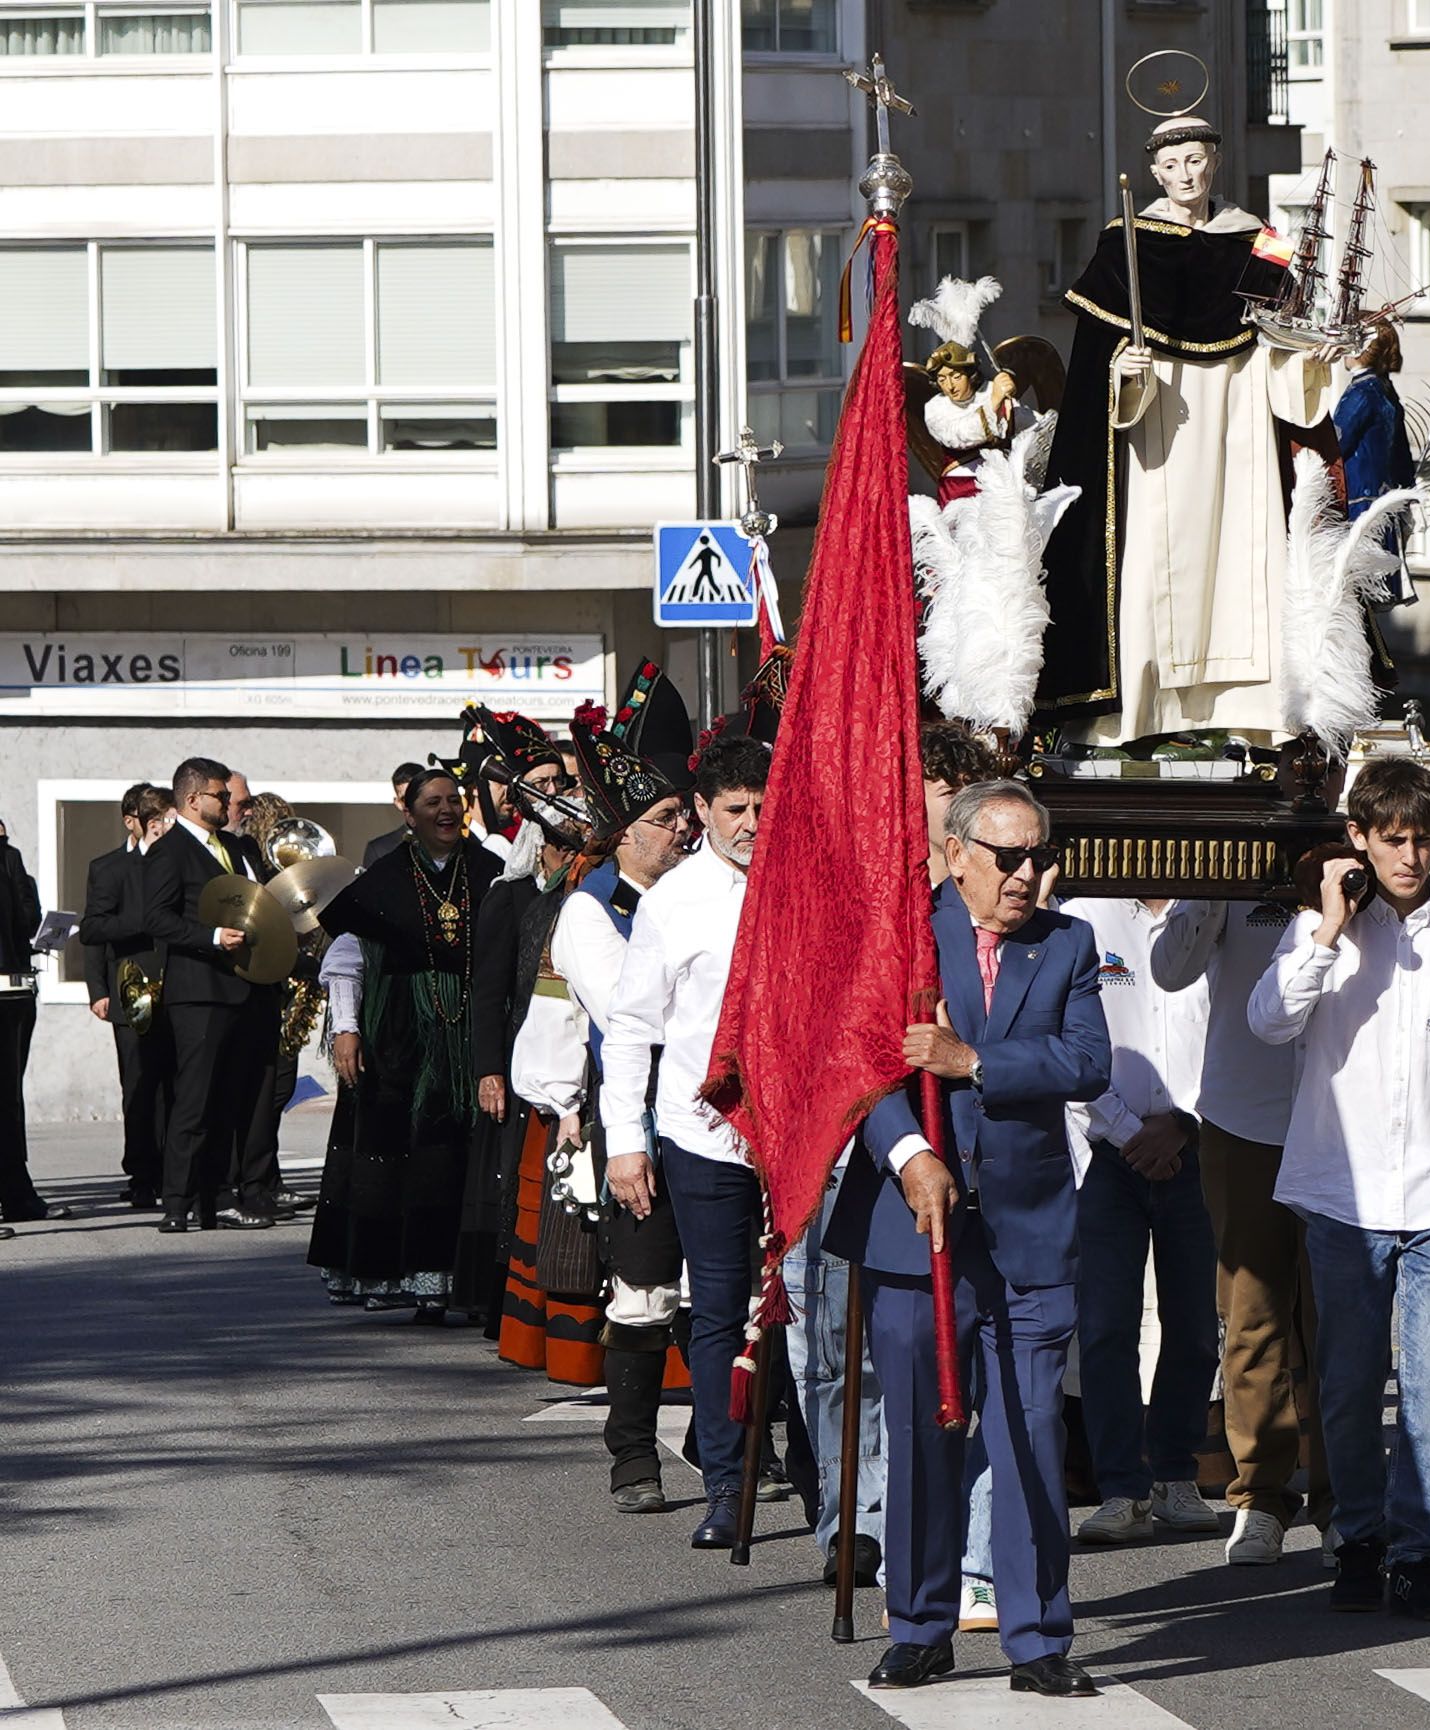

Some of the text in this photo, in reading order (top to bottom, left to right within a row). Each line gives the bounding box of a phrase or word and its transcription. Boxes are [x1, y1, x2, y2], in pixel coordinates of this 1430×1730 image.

[23, 644, 181, 683] Viaxes
[229, 644, 291, 657] Oficina 199
[341, 647, 443, 678] Linea
